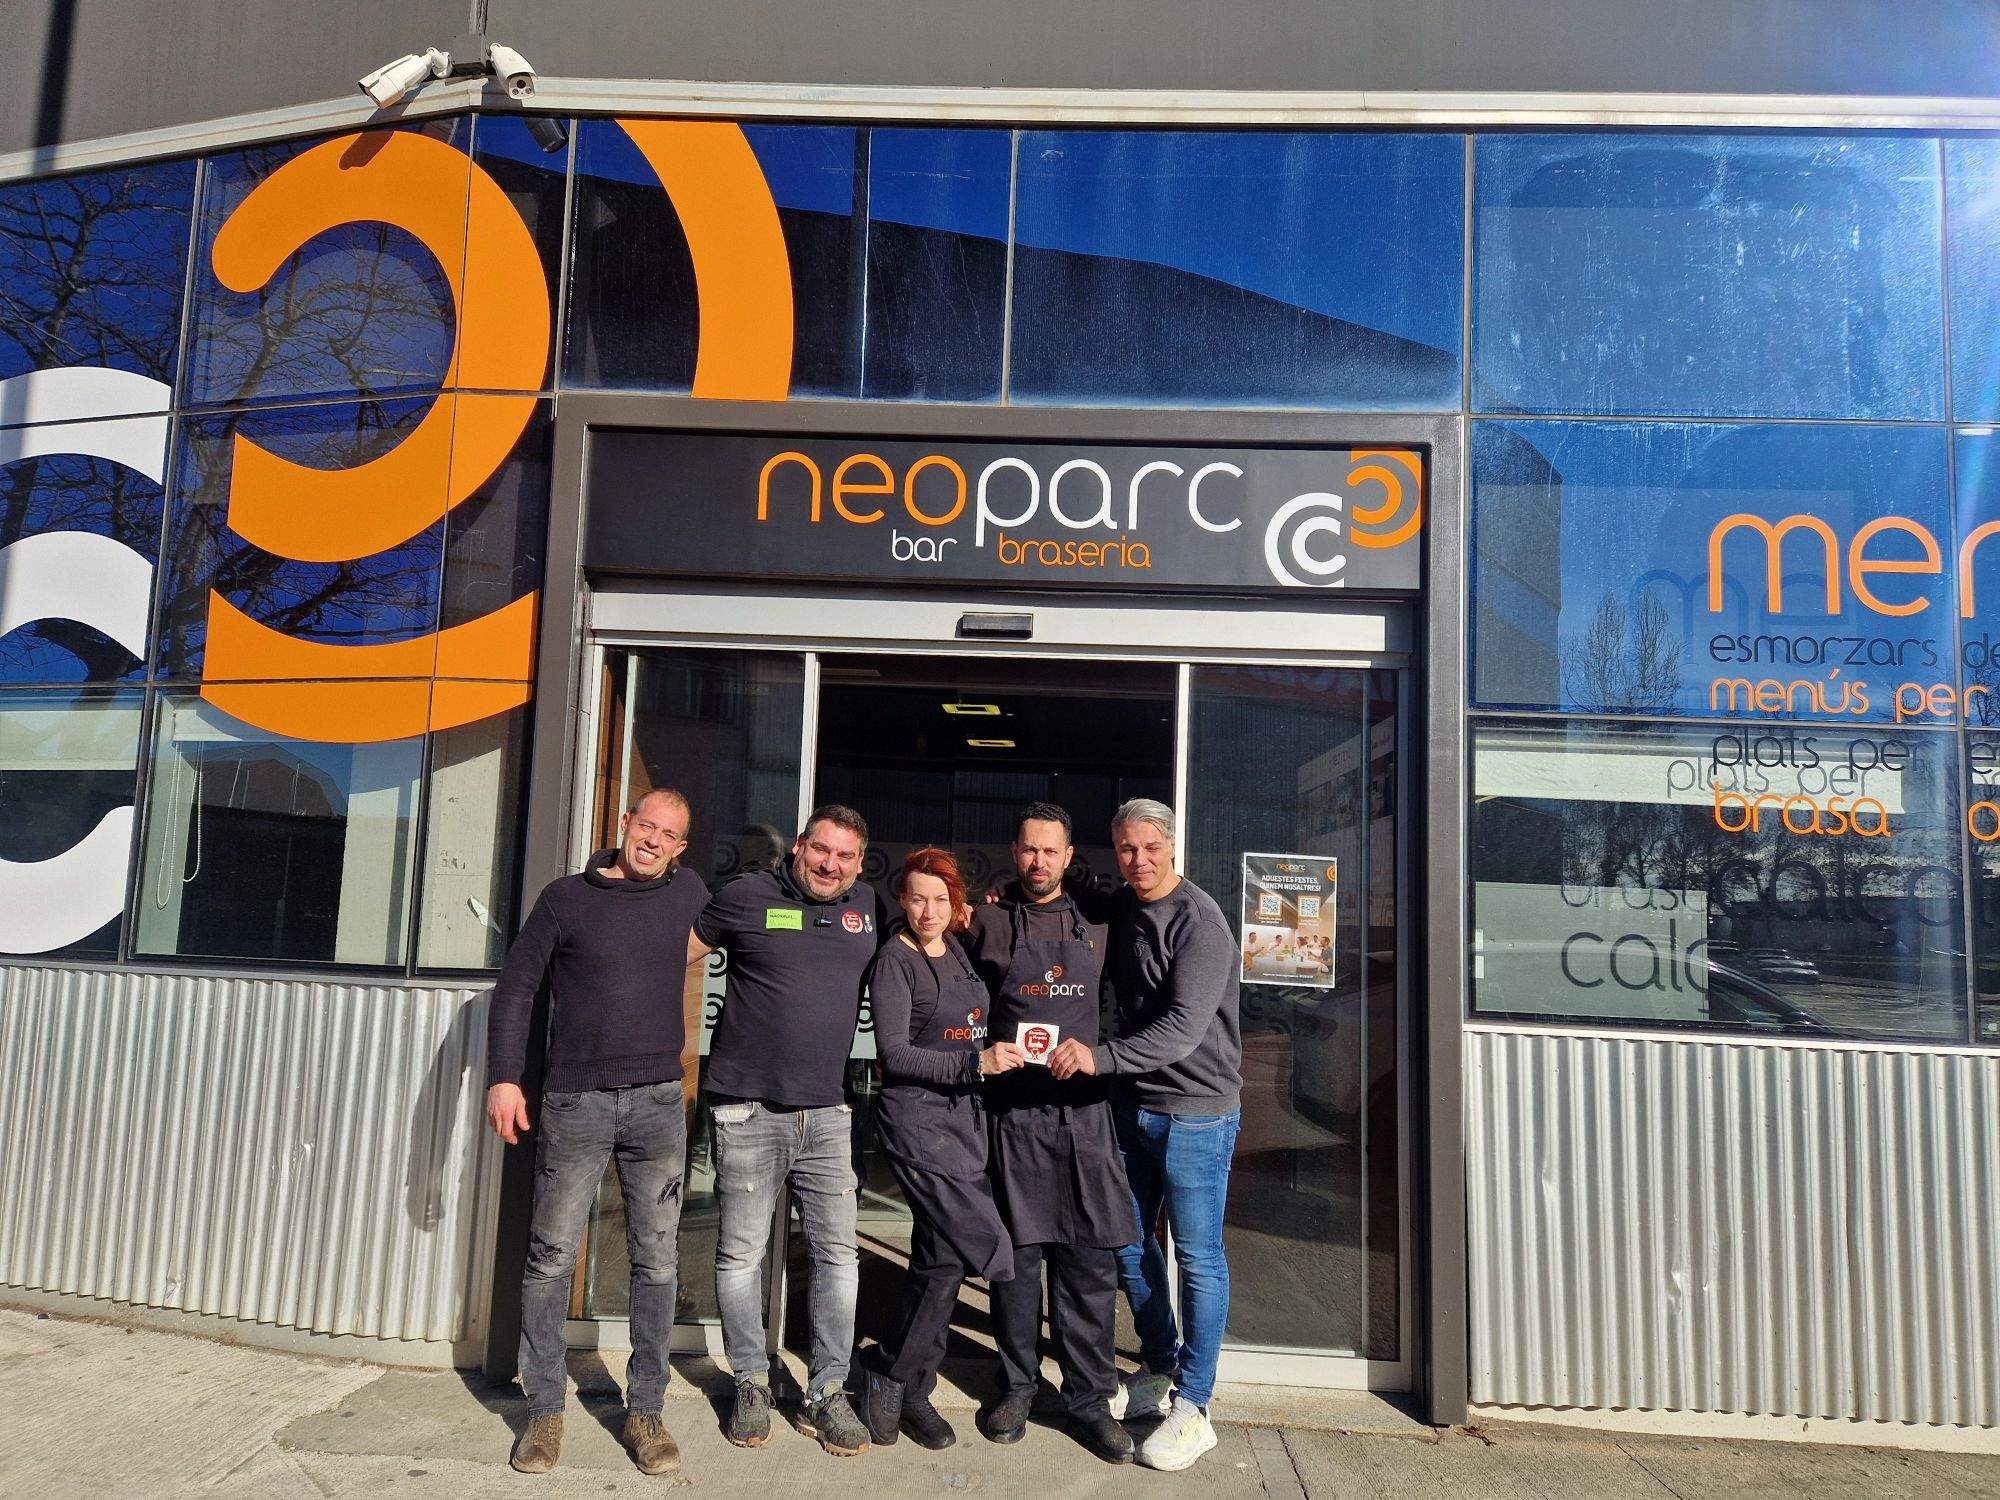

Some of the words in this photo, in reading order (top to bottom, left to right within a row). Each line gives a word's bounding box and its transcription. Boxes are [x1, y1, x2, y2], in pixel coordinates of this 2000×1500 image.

[757, 451, 1244, 547] neoparc
[891, 528, 958, 562] bar
[998, 532, 1152, 568] braseria
[1709, 634, 1938, 667] esmorzars
[1710, 668, 1870, 714] menús
[1892, 682, 1989, 723] per
[1712, 728, 1820, 776] plats
[1849, 737, 1938, 780] per
[1713, 780, 1893, 838] brasa
[1019, 984, 1086, 999] neoparc
[943, 1026, 988, 1042] neopar
